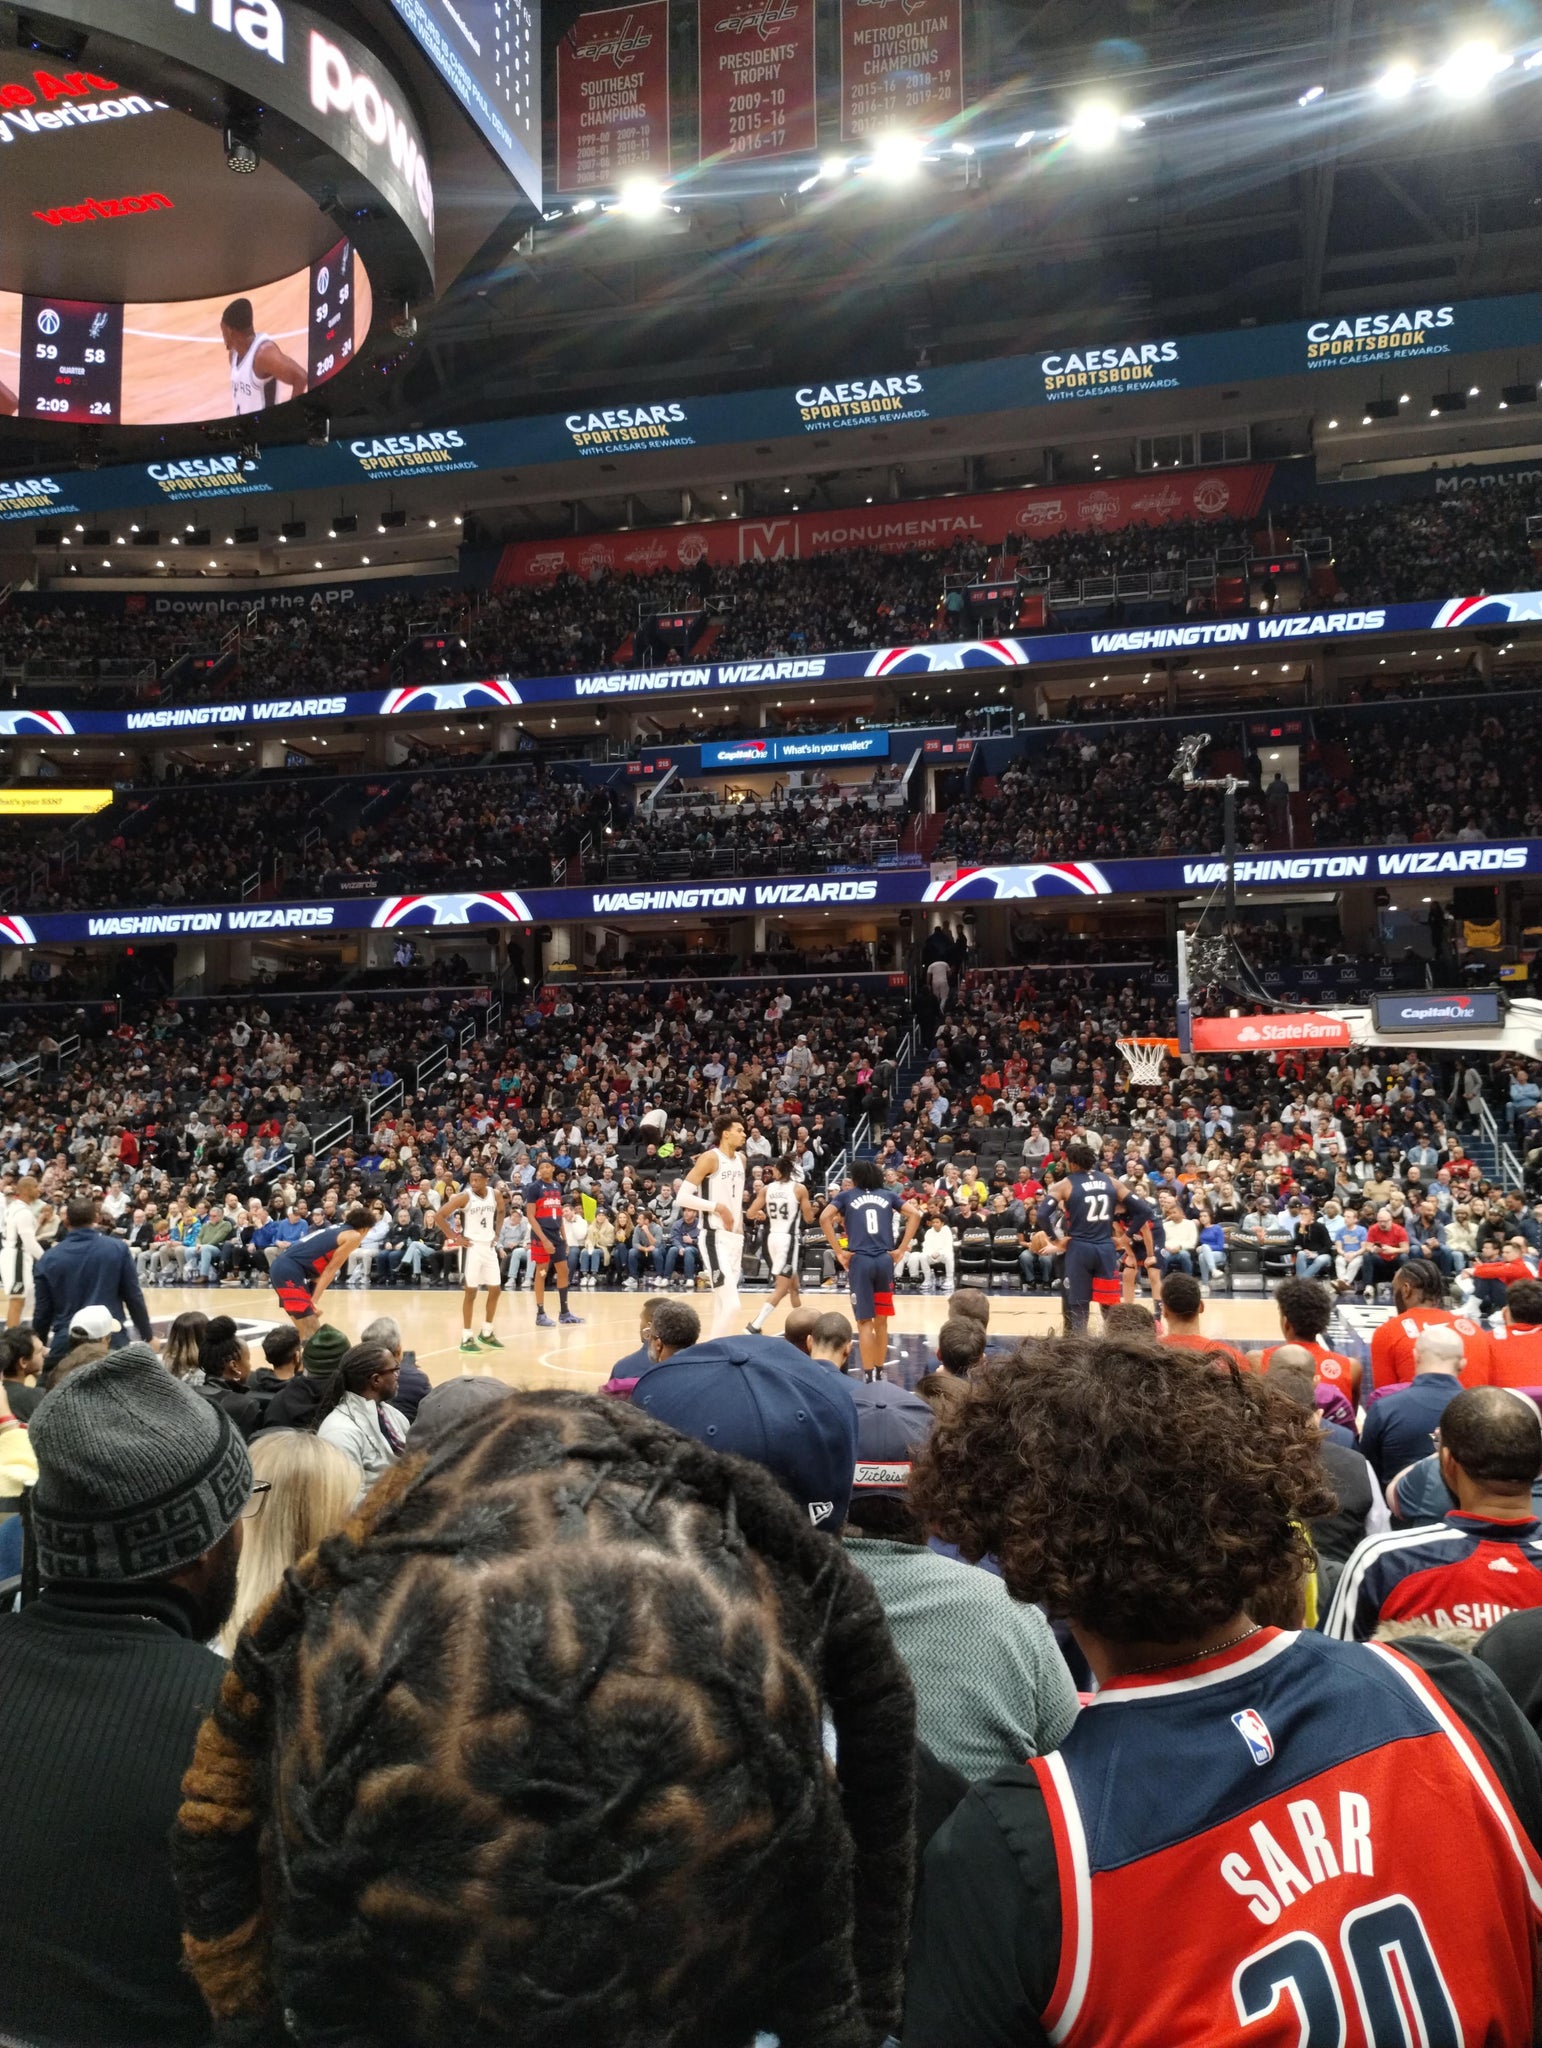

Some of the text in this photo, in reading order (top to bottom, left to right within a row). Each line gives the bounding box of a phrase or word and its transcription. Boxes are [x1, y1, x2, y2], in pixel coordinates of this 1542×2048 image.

[853, 16, 948, 46] METROPOLITAN
[872, 36, 929, 59] DIVISION
[863, 49, 938, 76] CHAMPIONS
[580, 72, 645, 97] SOUTHEAST
[733, 64, 782, 86] TROPHY
[905, 69, 951, 90] 2018-19
[588, 89, 637, 111] DIVISION
[729, 88, 785, 113] 2009-10
[851, 79, 896, 99] 2015-16
[905, 86, 952, 107] 2019-20
[3, 95, 153, 132] Verizon
[580, 104, 646, 127] CHAMPIONS
[851, 97, 896, 116] 2016-17
[729, 109, 785, 134] 2015-16
[729, 130, 786, 154] 2016-17
[33, 191, 174, 226] verizon
[316, 303, 328, 323] 59
[1307, 307, 1454, 343] CAESARS
[36, 343, 58, 360] 59
[1307, 330, 1425, 358] SPORTSBOOK
[84, 348, 106, 364] 58
[316, 354, 334, 377] 2:09
[1041, 341, 1179, 376] CAESARS
[1307, 357, 1336, 369] WITH
[1339, 351, 1391, 366] CAESARS
[59, 365, 85, 376] QUARTER
[1045, 364, 1154, 390] SPORTSBOOK
[795, 374, 924, 407] CAESARS
[1046, 391, 1073, 401] WITH
[1075, 385, 1125, 398] CAESARS
[36, 397, 70, 413] 2:09
[89, 402, 112, 415] :24
[800, 396, 904, 421] SPORTSBOOK
[565, 403, 687, 434] CAESARS
[804, 420, 831, 431] WITH
[833, 415, 878, 429] CAESARS
[350, 430, 466, 459] CAESARS
[572, 424, 670, 446] SPORTSBOOK
[359, 449, 453, 471] SPORTSBOOK
[579, 446, 603, 456] WITH
[604, 441, 648, 453] CAESARS
[158, 472, 247, 493] SPORTSBOOK
[368, 470, 392, 480] WITH
[393, 466, 433, 478] CAESARS
[192, 487, 228, 499] CAESARS
[812, 516, 983, 545] MONUMENTAL
[271, 594, 304, 608] the
[310, 589, 354, 605] APP
[1091, 610, 1386, 653] WASHINGTON WIZARDS
[575, 659, 826, 695] WASHINGTON WIZARDS
[126, 697, 347, 729] WASHINGTON WIZARDS
[783, 744, 811, 756] What's
[1183, 848, 1528, 884] WASHINGTON WIZARDS
[592, 881, 877, 912] WASHINGTON WIZARDS
[88, 907, 334, 936] WASHINGTON WIZARDS
[552, 1208, 557, 1220] 1
[768, 1202, 788, 1220] 24
[1084, 1194, 1109, 1222] 22
[480, 1217, 487, 1228] 4
[1220, 1790, 1374, 1926] SARR
[1231, 1893, 1466, 2048] 20
